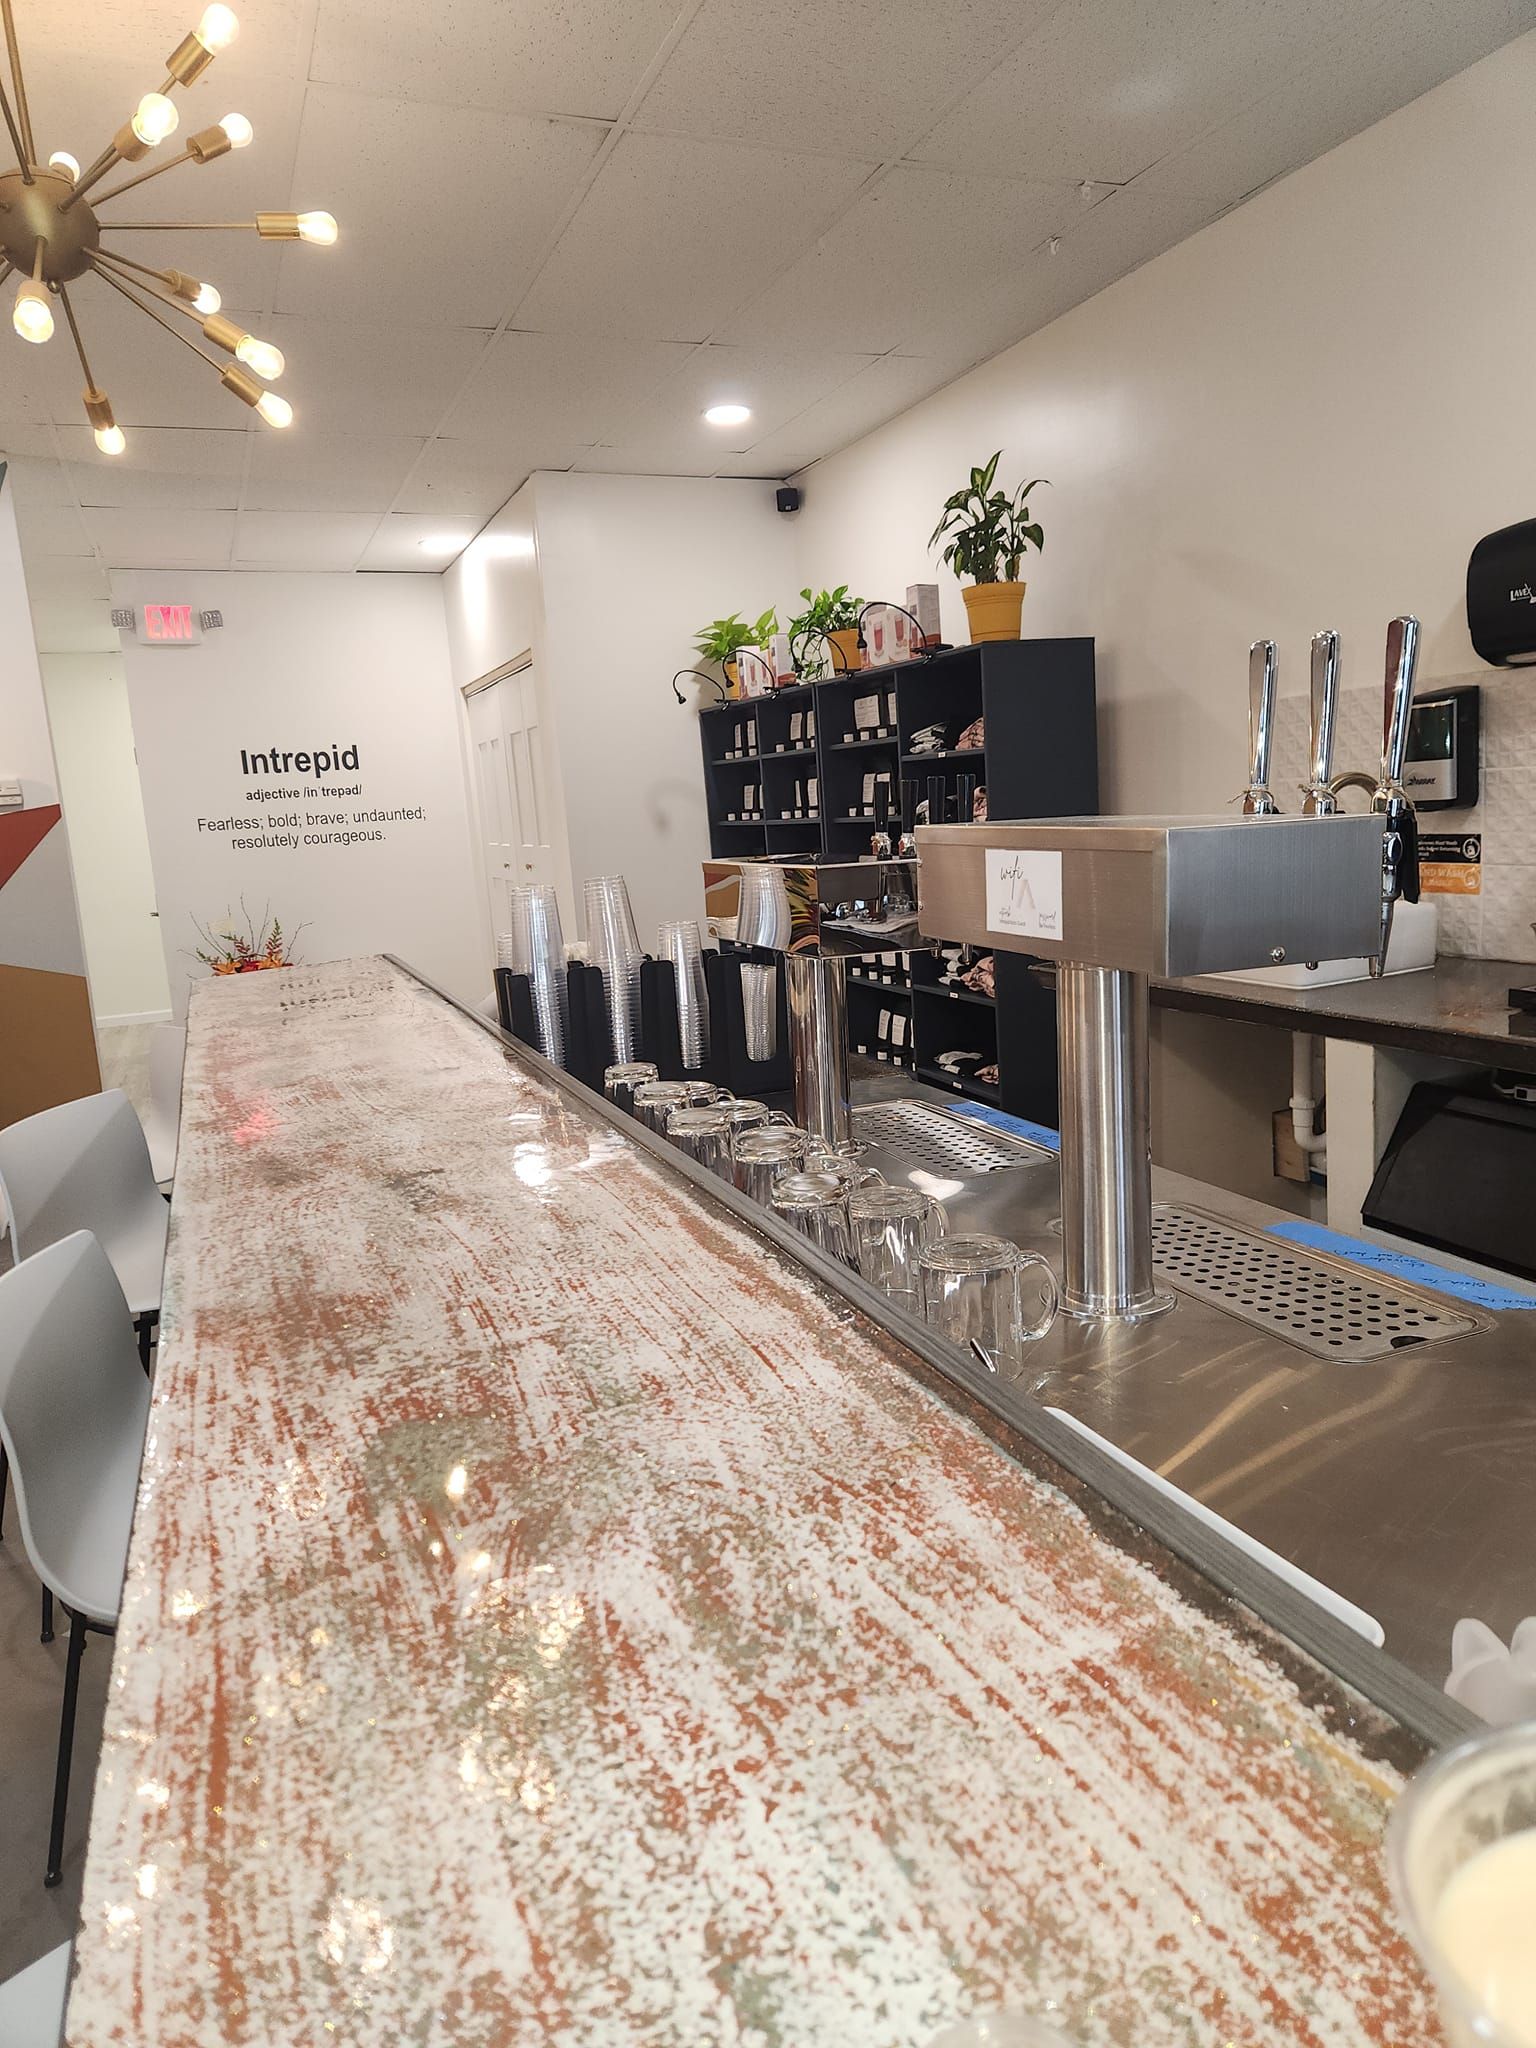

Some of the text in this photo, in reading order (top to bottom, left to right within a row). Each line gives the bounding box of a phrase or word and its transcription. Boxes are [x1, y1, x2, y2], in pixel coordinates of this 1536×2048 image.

[1510, 583, 1532, 602] LAVEX
[144, 605, 192, 640] EXIT
[239, 743, 360, 779] Intrepid
[246, 785, 300, 802] adjective
[197, 807, 426, 833] Fearless; bold; brave; undaunted;
[231, 830, 387, 850] resolutely courageous.
